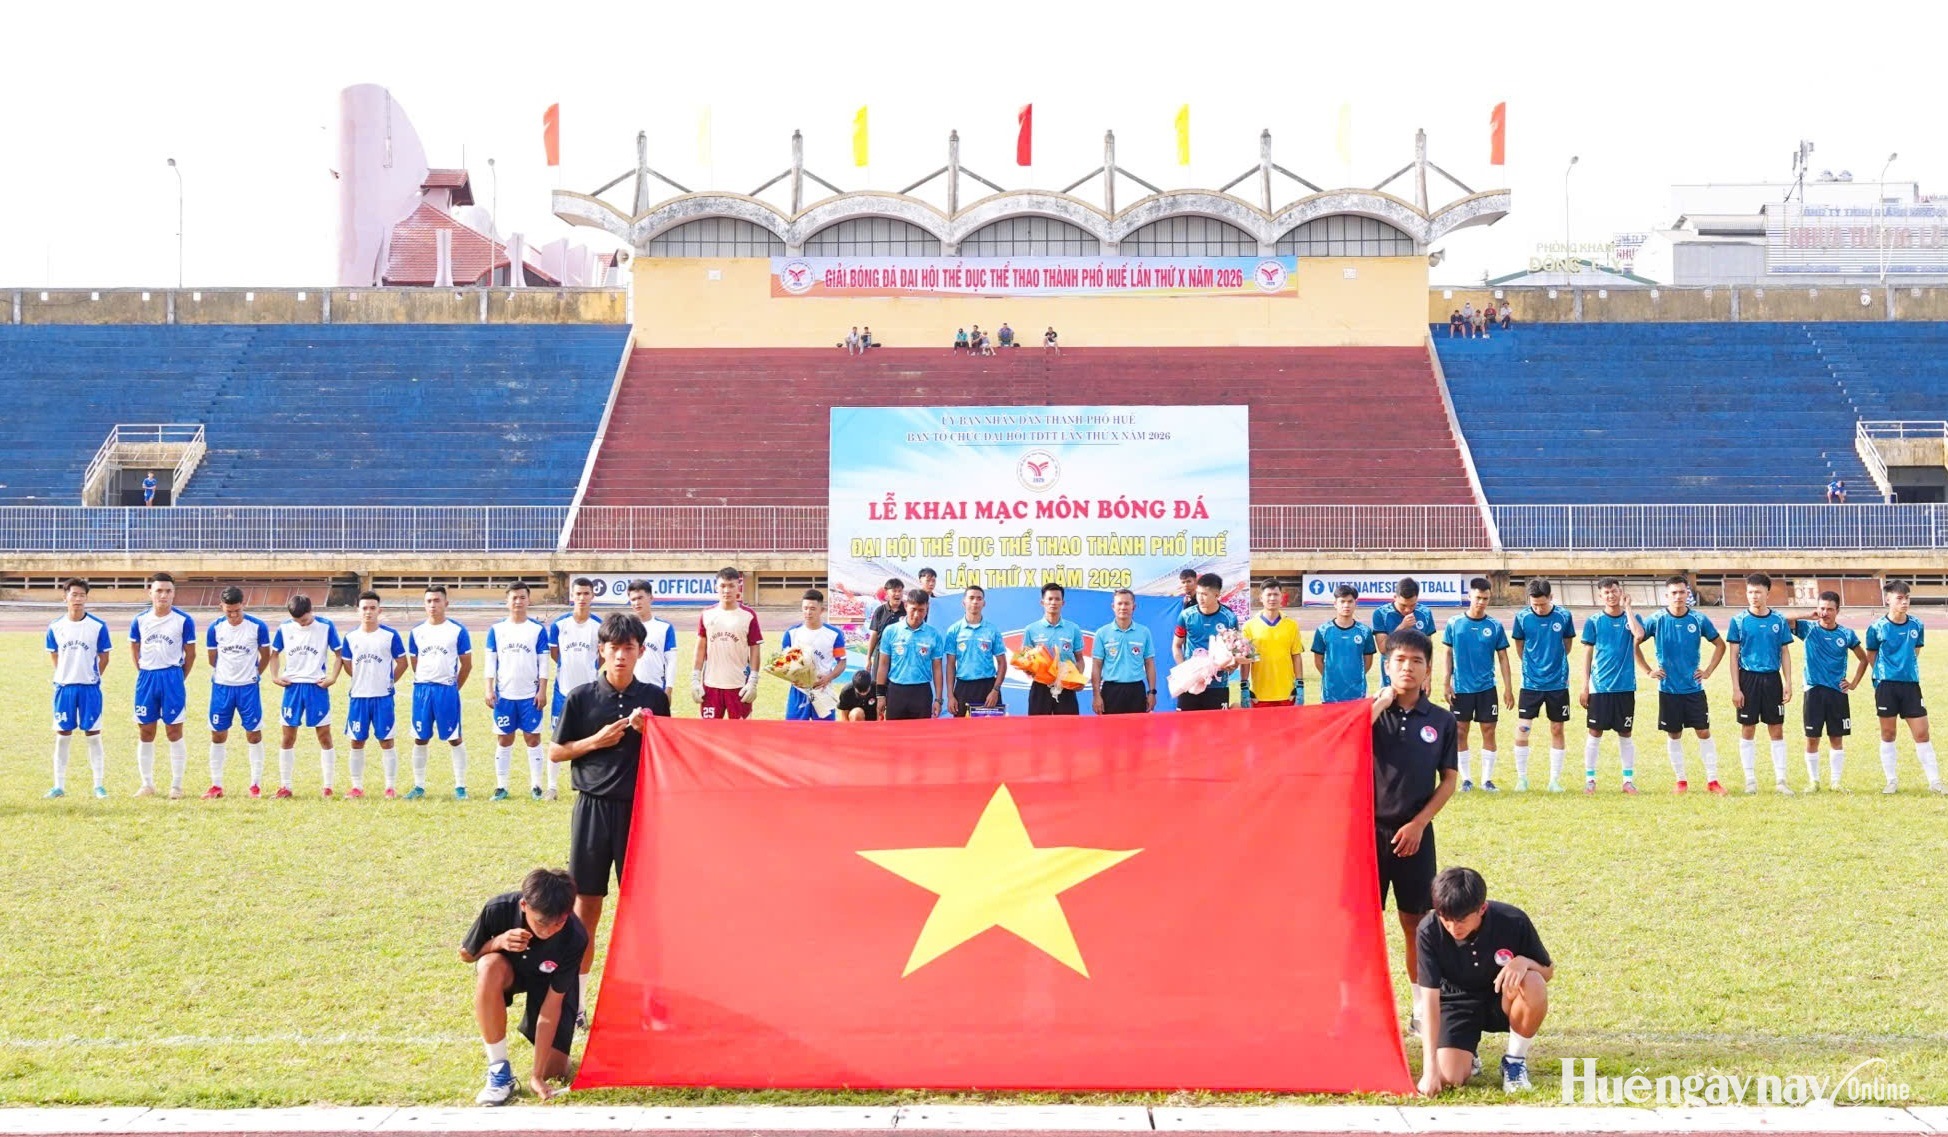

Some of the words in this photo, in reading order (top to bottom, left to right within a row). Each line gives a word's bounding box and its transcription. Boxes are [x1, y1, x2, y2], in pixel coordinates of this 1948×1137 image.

[825, 263, 847, 288] GIẢI
[850, 265, 879, 288] BÓNG
[882, 264, 897, 288] ĐÁ
[900, 268, 918, 292] ĐẠI
[921, 265, 939, 292] HỘI
[942, 261, 963, 288] THỂ
[965, 268, 987, 292] DỤC
[989, 261, 1010, 288] THỂ
[1012, 268, 1039, 288] THAO
[1043, 264, 1078, 288] THÀNH
[1082, 261, 1104, 288] PHỐ
[1106, 261, 1129, 288] HUẾ
[1131, 261, 1151, 288] LẦN
[1154, 264, 1177, 288] THỨ
[1178, 268, 1186, 288] X
[1188, 263, 1214, 288] NĂM
[1216, 268, 1244, 288] 2026
[959, 415, 981, 425] BAN
[907, 432, 929, 441] BAN
[1030, 431, 1058, 441] TDTT
[1111, 431, 1119, 441] X
[1148, 431, 1171, 441] 2026
[868, 492, 897, 520] LỄ
[904, 501, 967, 520] KHAI
[974, 500, 1029, 524] MẠC
[1035, 494, 1090, 519] MÔN
[1097, 495, 1166, 519] BÓNG
[1173, 495, 1209, 519] ĐÁ
[851, 537, 881, 562] ĐẠI
[886, 534, 916, 562] HỘI
[921, 529, 955, 557] THỂ
[958, 537, 995, 561] DỤC
[999, 529, 1033, 557] THỂ
[1036, 536, 1082, 556] THAO
[1086, 531, 1146, 556] THÀNH
[1150, 529, 1188, 556] PHỐ
[1192, 529, 1229, 556] HUẾ
[946, 563, 980, 590] LẦN
[985, 565, 1021, 590] THỨ
[1024, 568, 1037, 589] X
[1041, 564, 1084, 588] NĂM
[1088, 568, 1132, 589] 2026
[612, 579, 719, 596] @.OFFICIAL
[283, 706, 292, 718] 14
[703, 707, 715, 719] 25
[416, 721, 422, 732] 5
[497, 716, 510, 727] 22
[1842, 718, 1850, 729] 10
